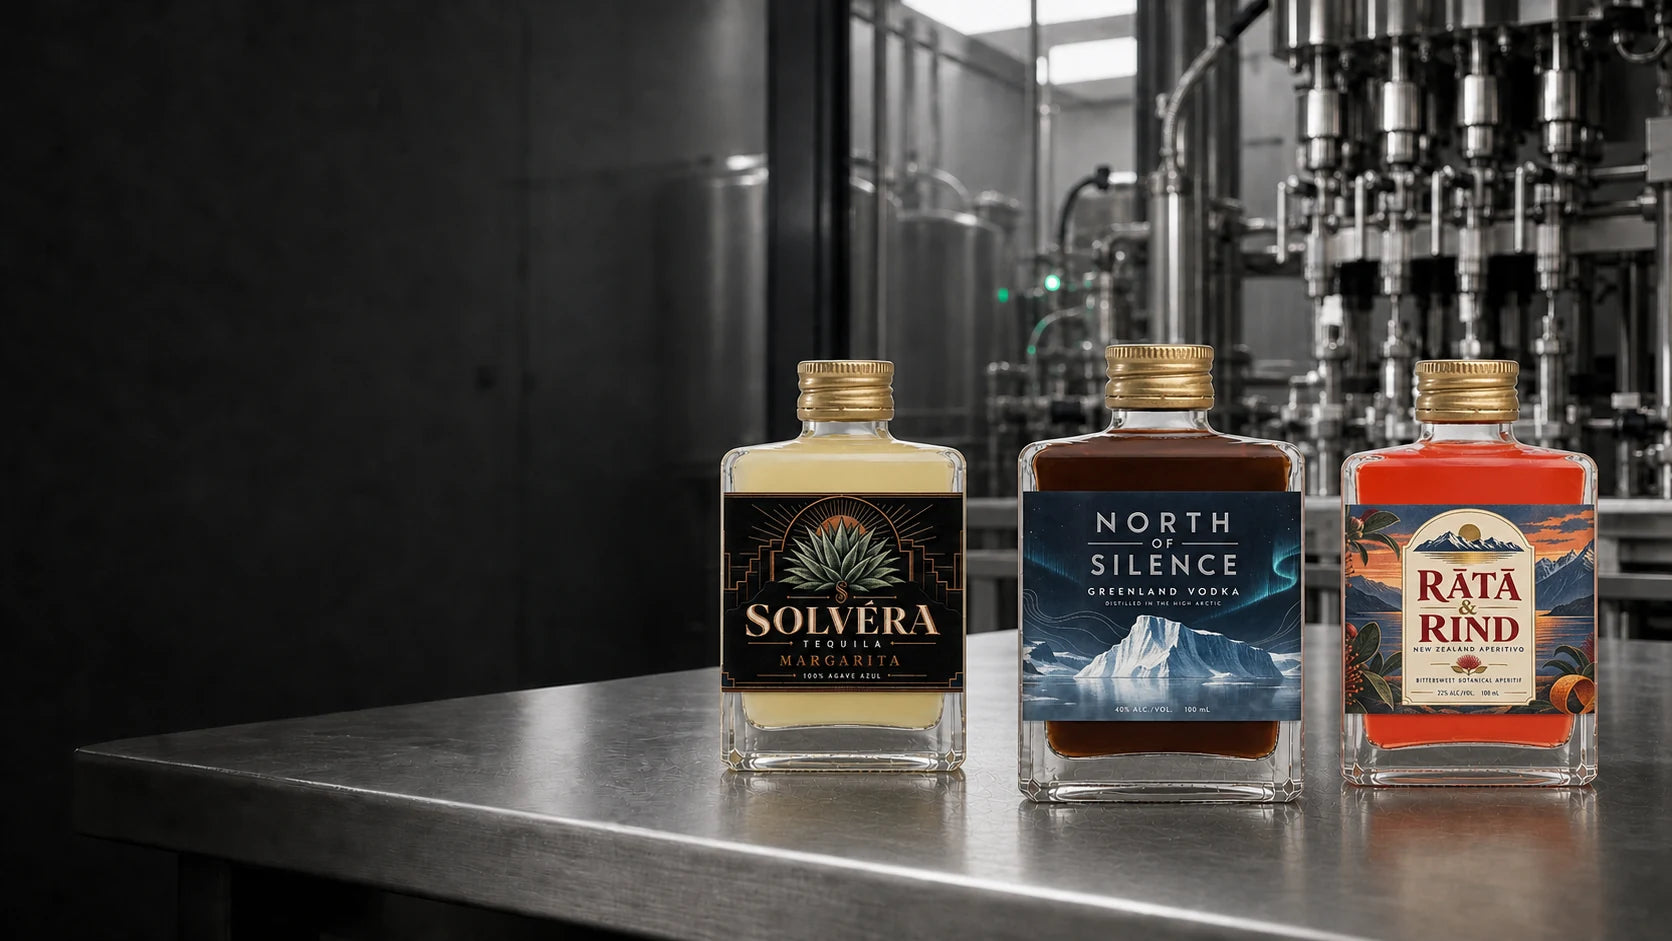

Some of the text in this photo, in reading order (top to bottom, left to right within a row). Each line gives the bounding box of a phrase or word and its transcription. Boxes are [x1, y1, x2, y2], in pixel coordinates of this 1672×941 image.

[1096, 512, 1229, 533] NORTH
[1152, 539, 1173, 548] OF
[1090, 554, 1237, 576] SILENCE
[1087, 588, 1240, 596] GREENLAND VODKA
[1417, 568, 1522, 602] RĀTĀ
[1458, 599, 1477, 615] &
[745, 600, 941, 637] SOLVÉRA
[1418, 614, 1520, 643] RIND
[803, 640, 881, 648] TEQUILA
[780, 655, 900, 667] MARGARITA
